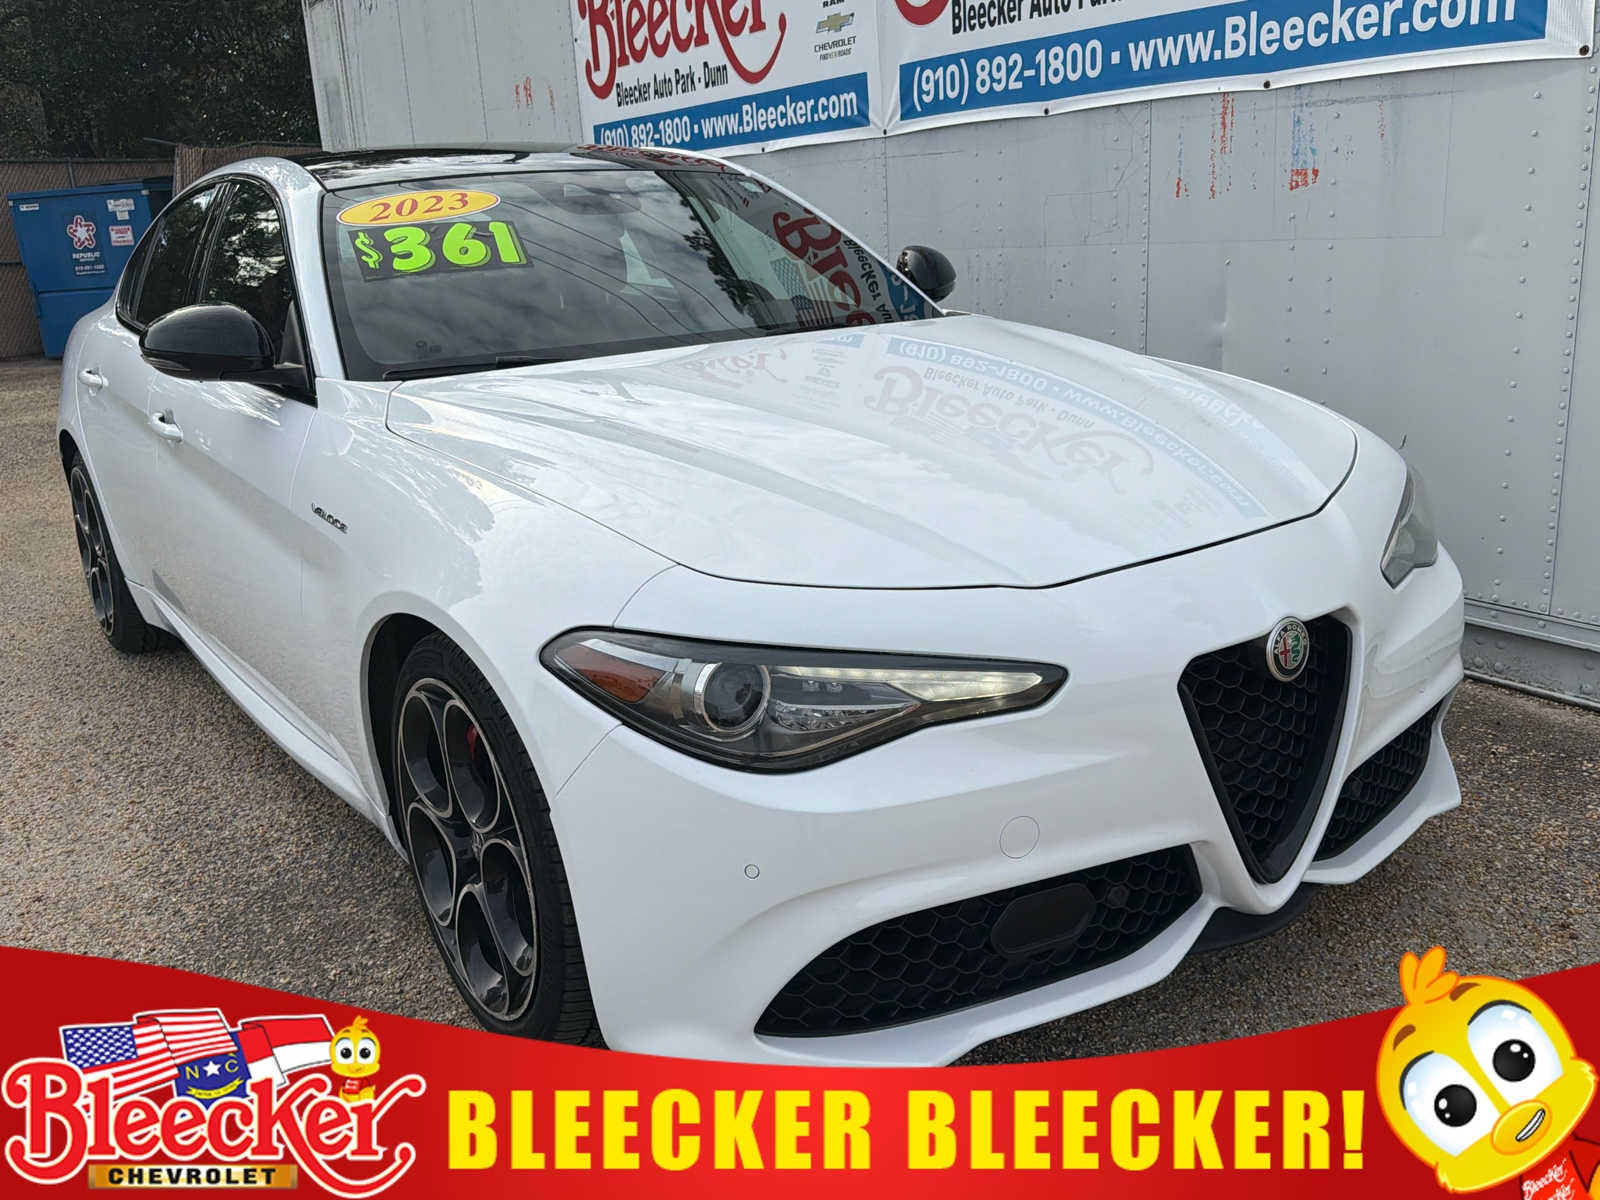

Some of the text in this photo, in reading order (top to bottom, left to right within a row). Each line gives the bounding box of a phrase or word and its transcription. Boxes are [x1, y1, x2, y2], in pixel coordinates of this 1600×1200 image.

[951, 0, 1021, 35] Bleecker
[578, 0, 787, 100] Bleecker
[814, 35, 857, 53] CHEVROLET
[913, 0, 1516, 112] (910) 892-1800 www.Bleecker.com
[616, 61, 729, 107] Bleecker Auto Park Dunn
[631, 115, 691, 148] 892-1800
[701, 89, 858, 138] www.Bleecker.com
[369, 193, 469, 222] 2023
[355, 222, 527, 273] $361
